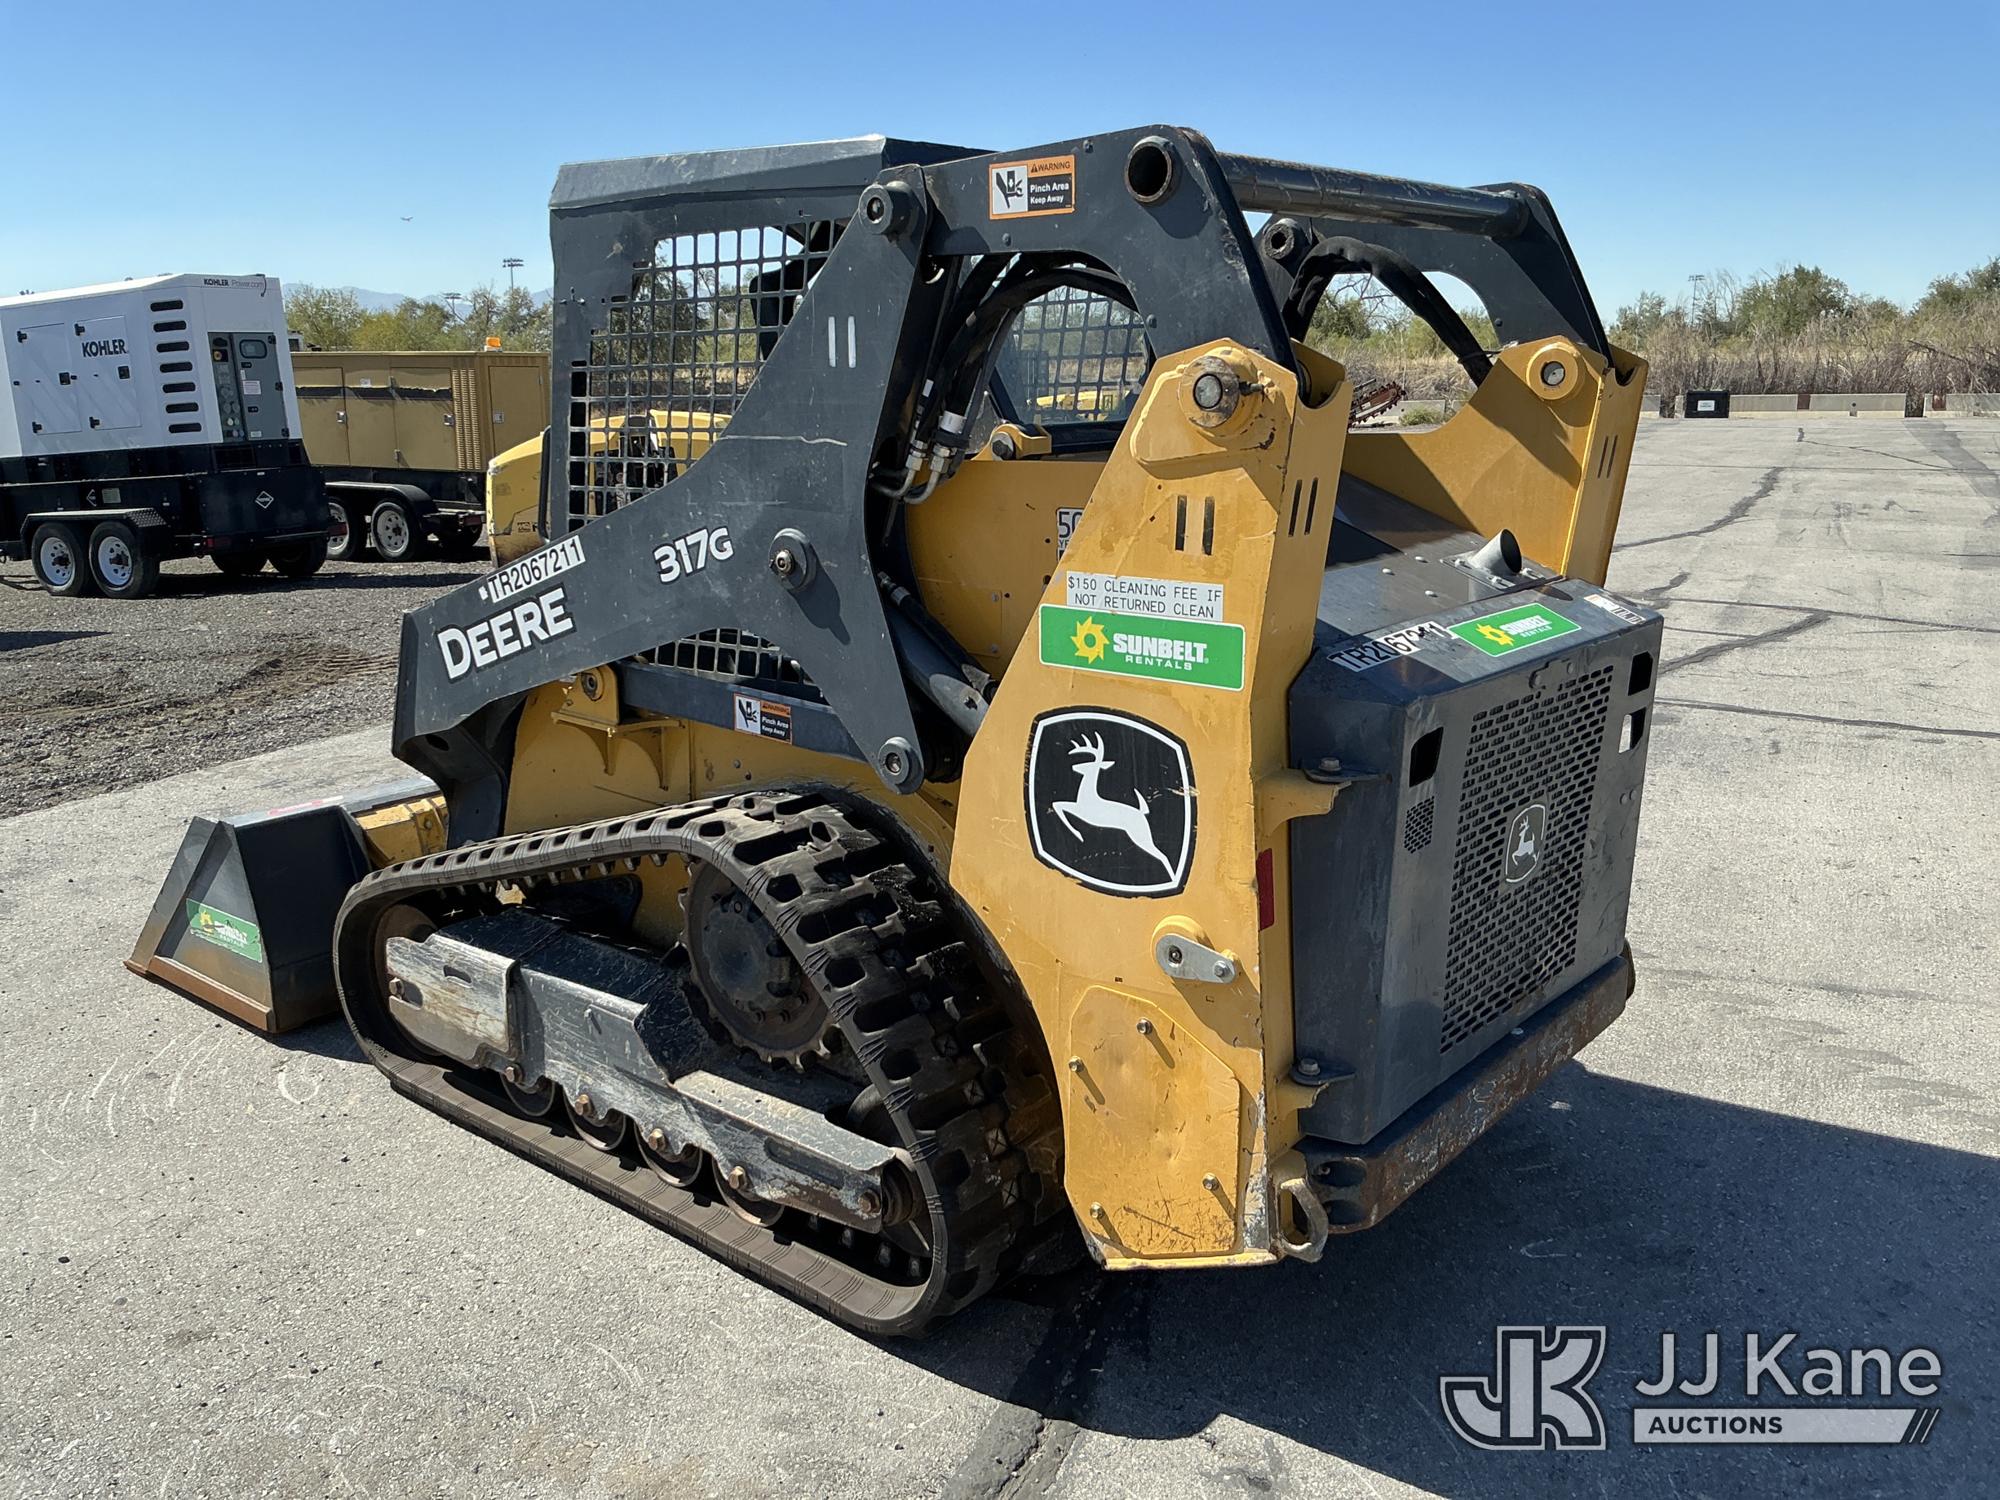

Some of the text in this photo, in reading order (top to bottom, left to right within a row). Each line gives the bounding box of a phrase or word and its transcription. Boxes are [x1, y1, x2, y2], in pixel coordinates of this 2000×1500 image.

[1038, 161, 1071, 171] WARNING
[1030, 182, 1070, 193] Pinch Area
[1030, 197, 1046, 205] Keep
[203, 278, 229, 286] KOHLER
[82, 339, 127, 357] KOHLER
[654, 526, 734, 583] 317G
[488, 538, 581, 599] TR2067211
[1068, 576, 1222, 602] $150 CLEANING FEE IF
[1075, 593, 1214, 618] NOT RETURNED CLEAN
[437, 587, 573, 679] DEERE
[1113, 633, 1207, 664] SUNBELT
[1125, 654, 1192, 671] RENTALS
